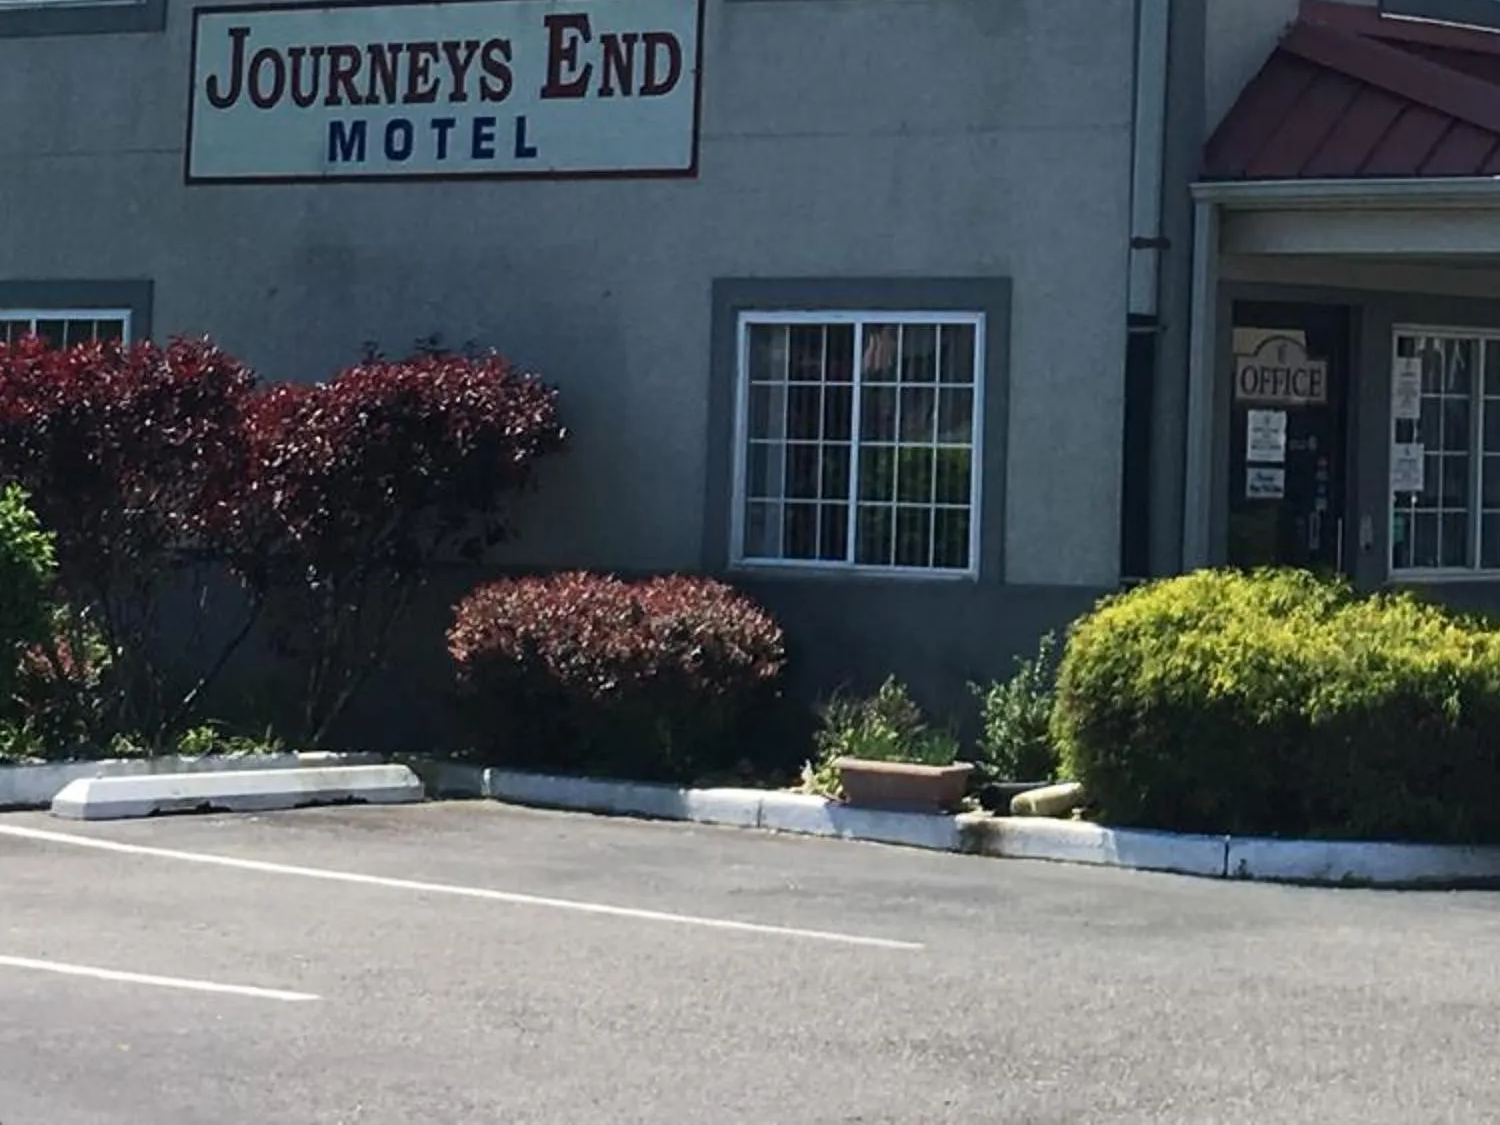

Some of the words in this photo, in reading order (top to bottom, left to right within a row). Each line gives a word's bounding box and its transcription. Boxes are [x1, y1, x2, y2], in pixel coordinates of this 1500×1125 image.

[206, 27, 513, 109] JOURNEYS
[540, 13, 683, 99] END
[328, 116, 538, 162] MOTEL
[1240, 365, 1322, 397] OFFICE
